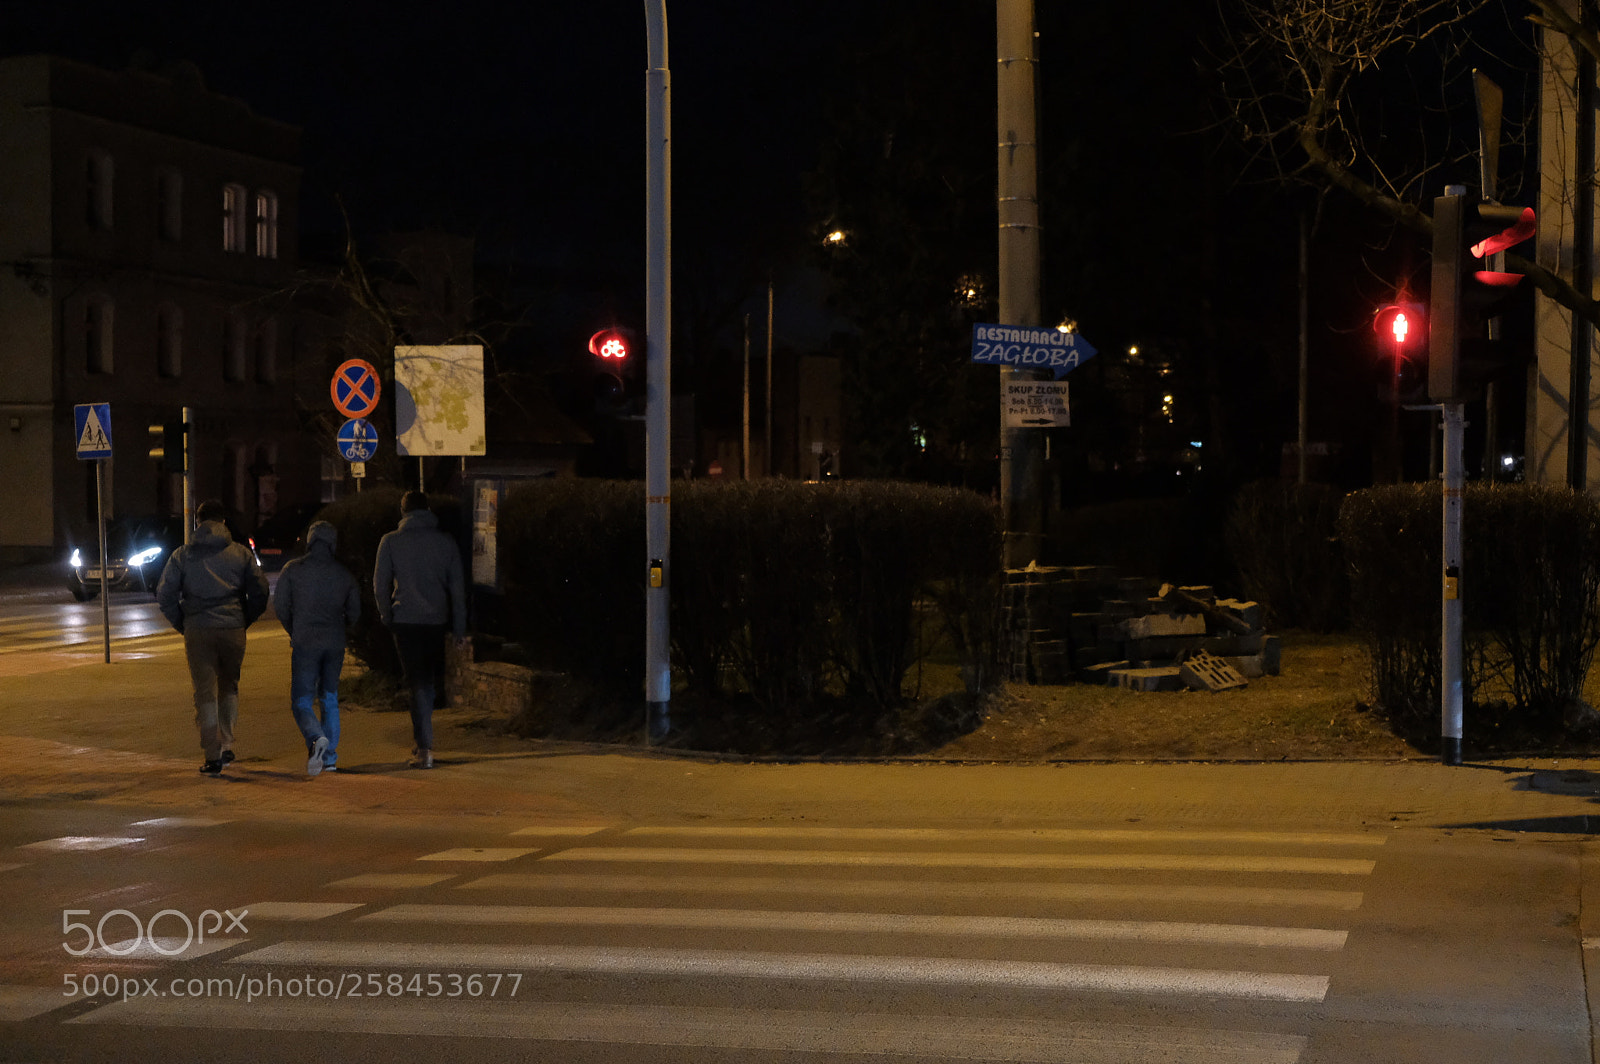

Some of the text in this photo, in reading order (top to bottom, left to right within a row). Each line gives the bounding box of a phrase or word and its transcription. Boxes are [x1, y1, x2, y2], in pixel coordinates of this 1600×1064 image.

[977, 328, 1074, 346] RESTAURACJA
[974, 343, 1079, 367] ZAGŁOBA
[1008, 386, 1067, 394] SKUP ZŁOMU
